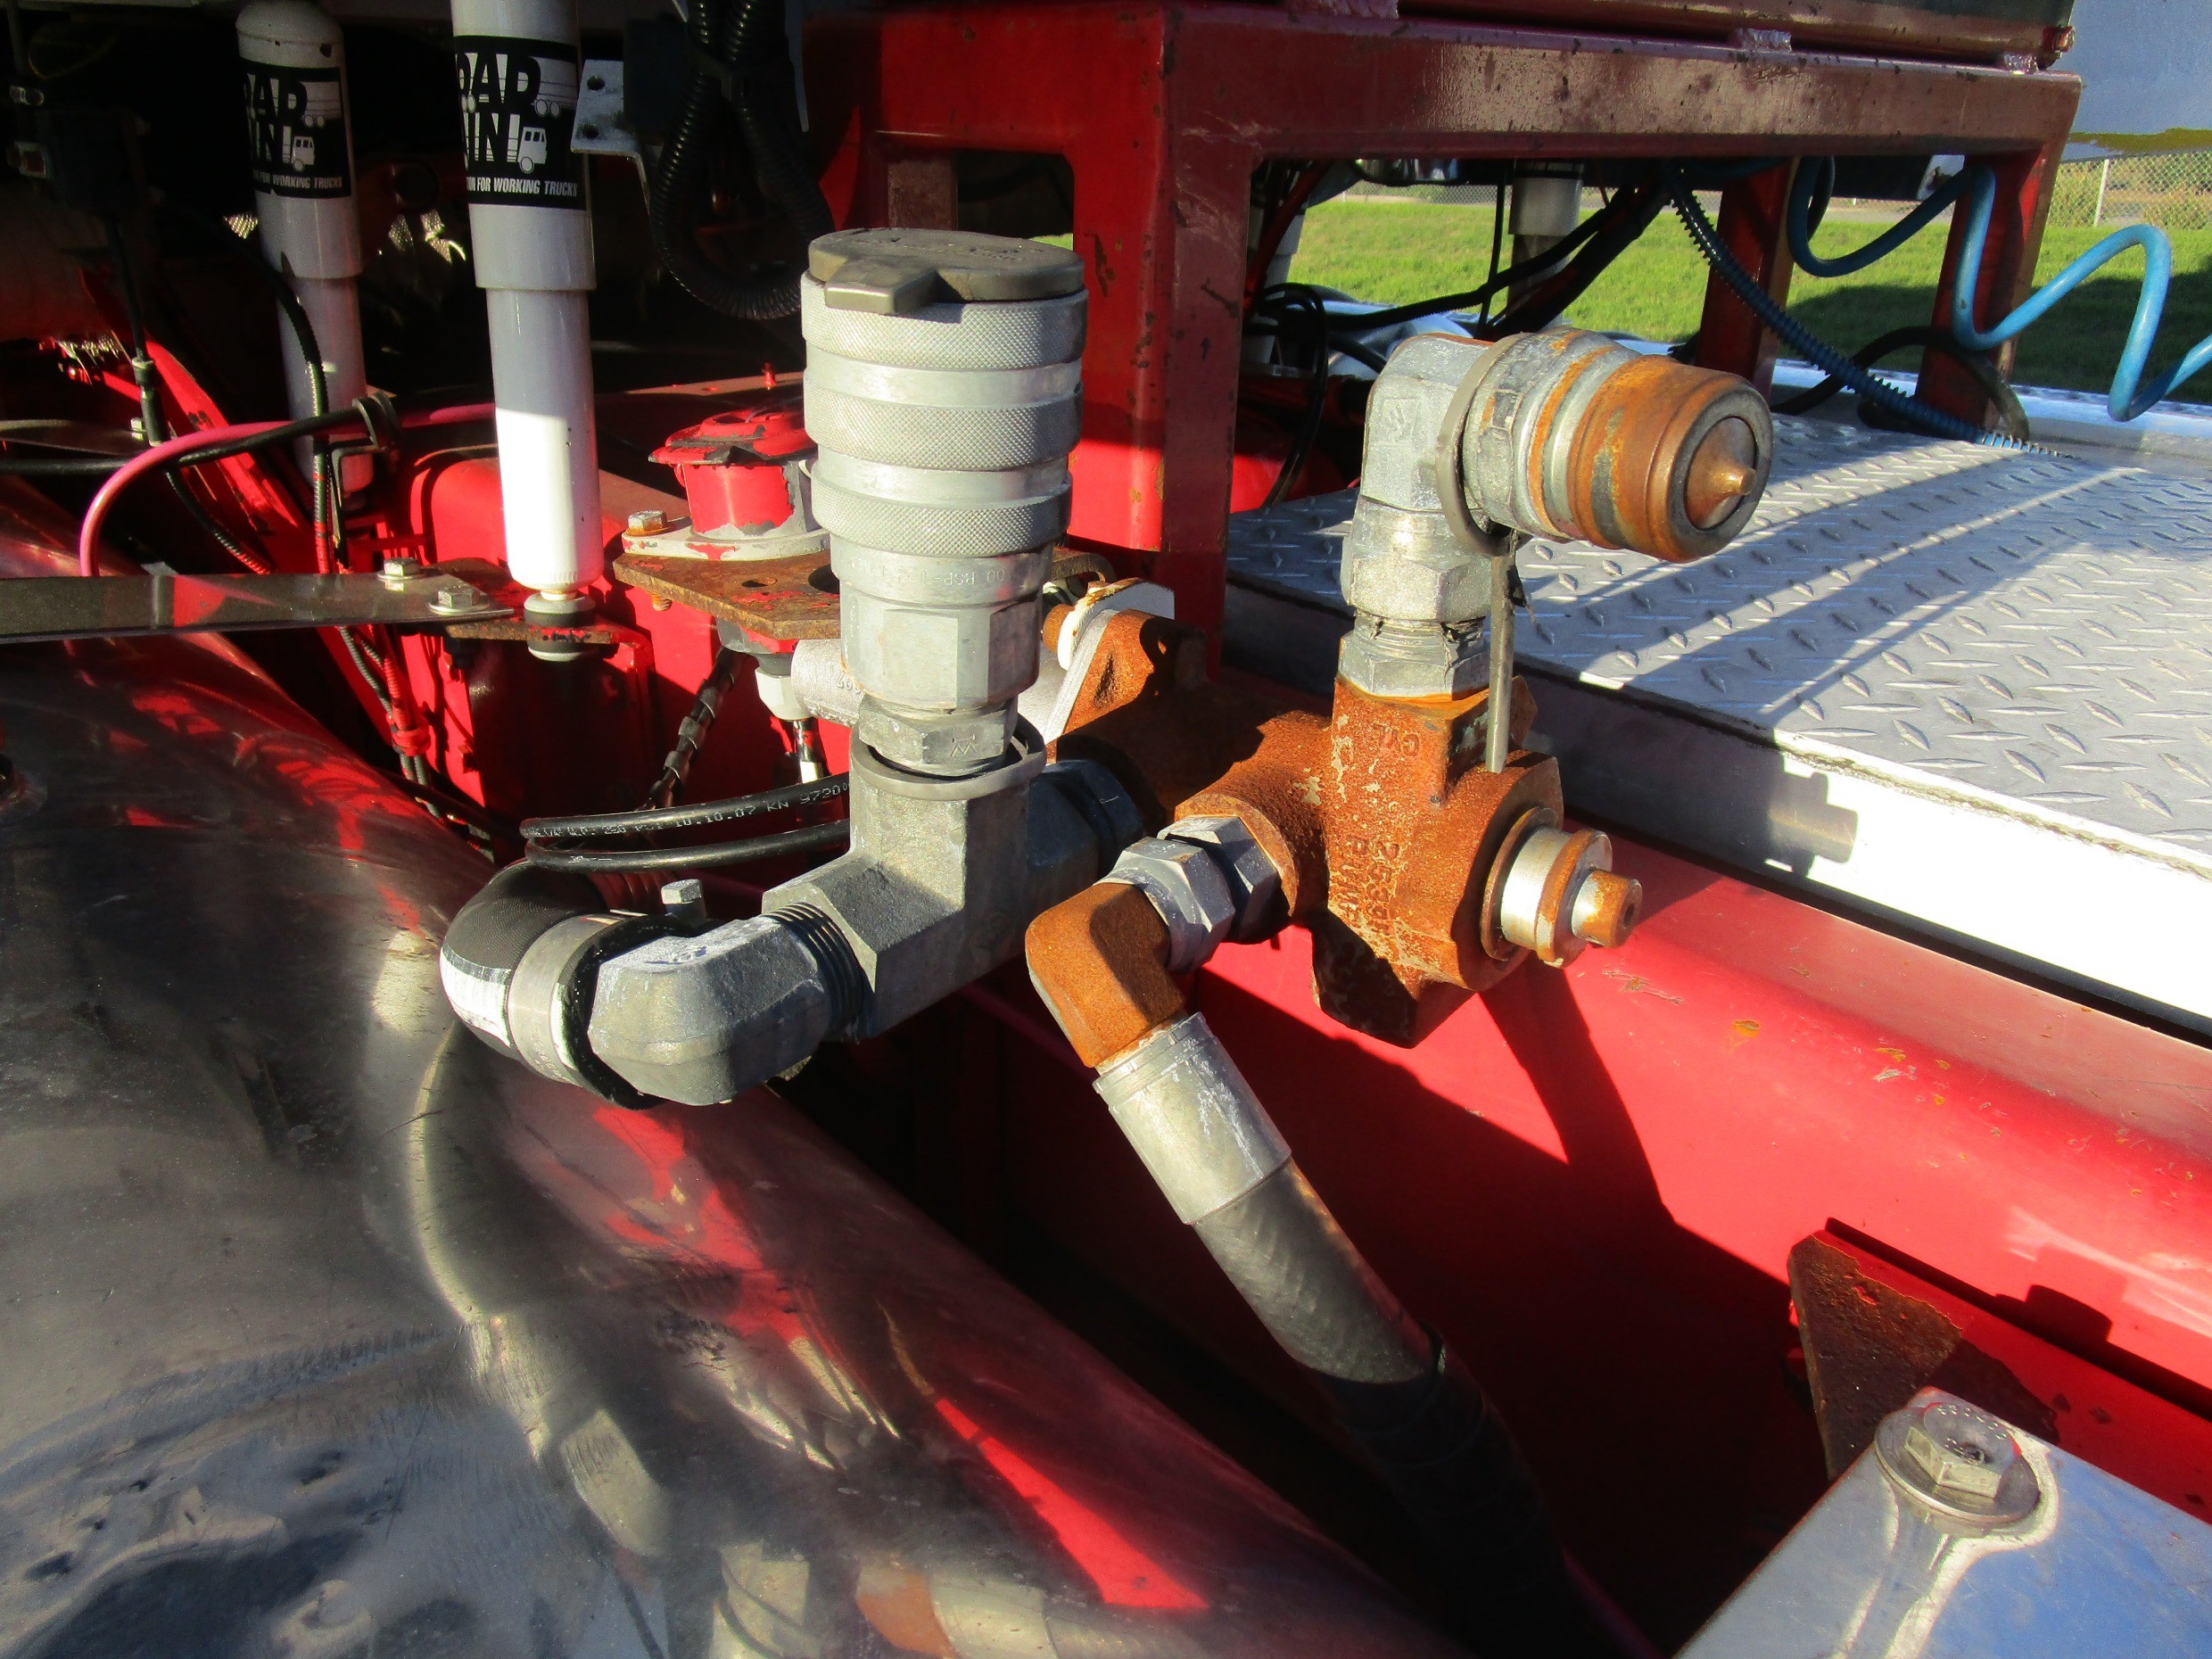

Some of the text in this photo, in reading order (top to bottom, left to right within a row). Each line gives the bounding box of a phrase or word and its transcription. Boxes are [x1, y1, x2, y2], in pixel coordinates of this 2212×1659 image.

[243, 71, 307, 120] OAD
[455, 52, 541, 109] OAD
[272, 173, 311, 189] WORKING
[476, 177, 491, 193] FOR
[493, 177, 541, 194] WORKING
[544, 180, 578, 197] TRUCKS
